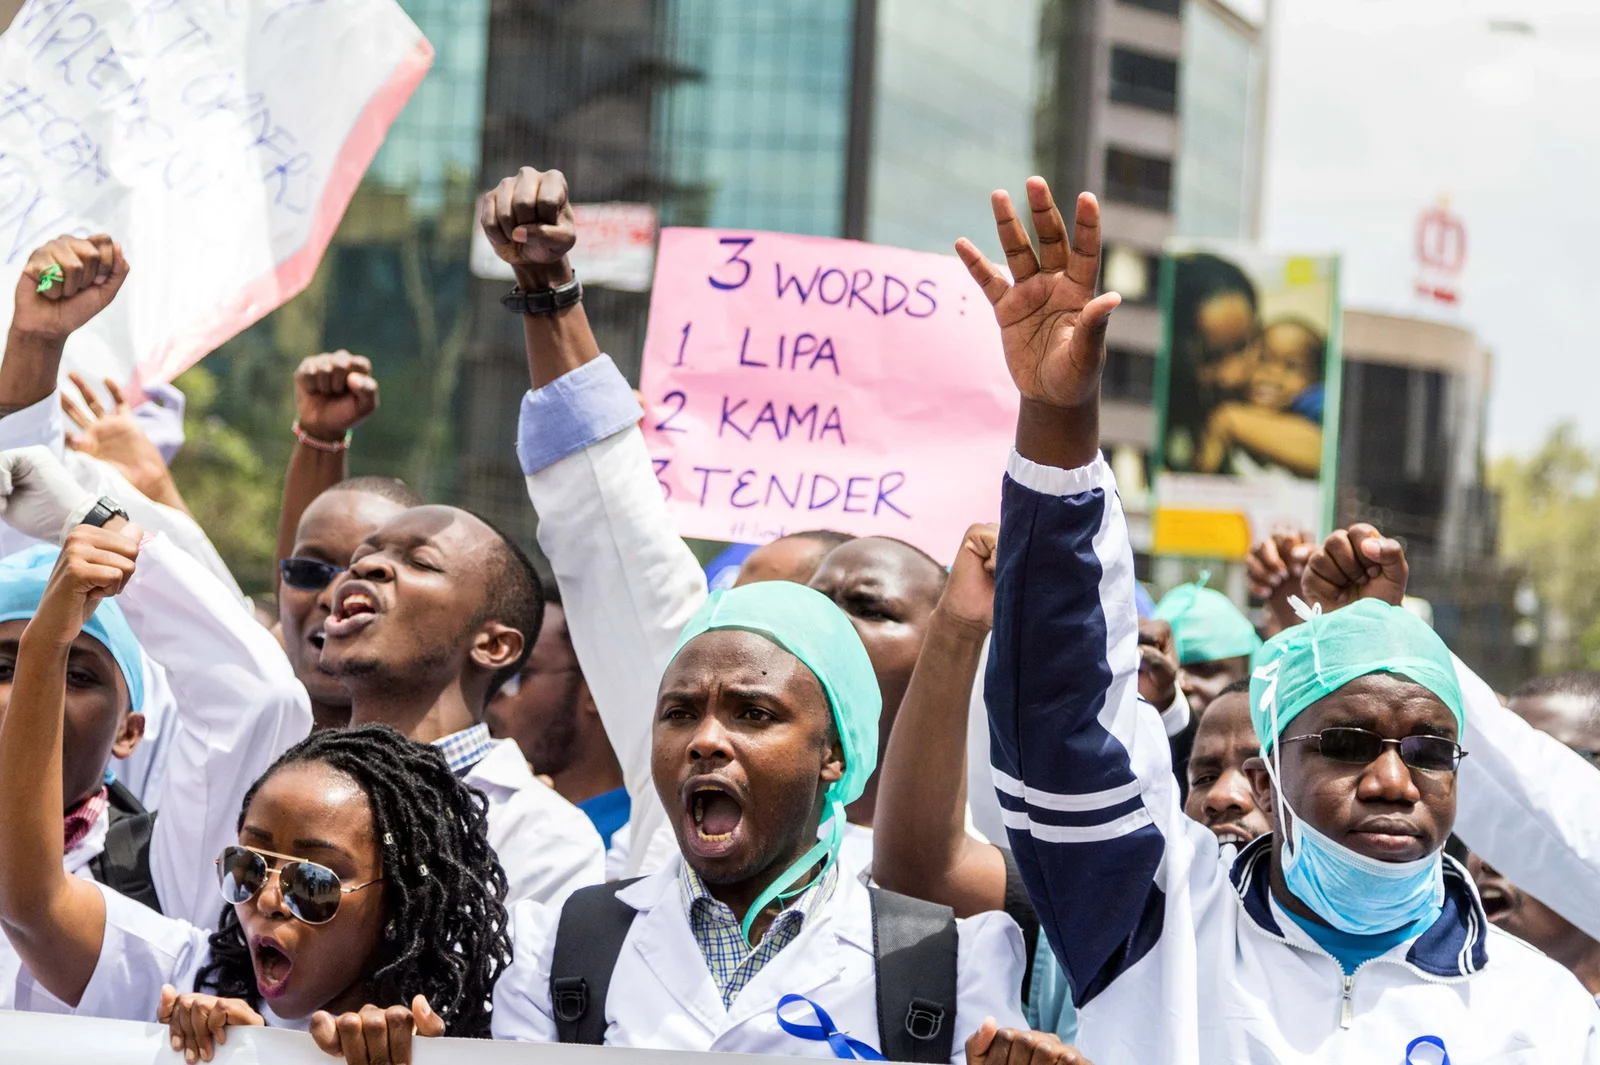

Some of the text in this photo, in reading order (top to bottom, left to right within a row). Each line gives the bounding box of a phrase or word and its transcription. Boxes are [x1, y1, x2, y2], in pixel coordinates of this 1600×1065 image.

[708, 237, 754, 291] 3
[775, 262, 938, 319] WORDS
[672, 321, 840, 377] 1 LIPA
[655, 390, 847, 446] 2 KAMA
[693, 466, 912, 519] TENDER
